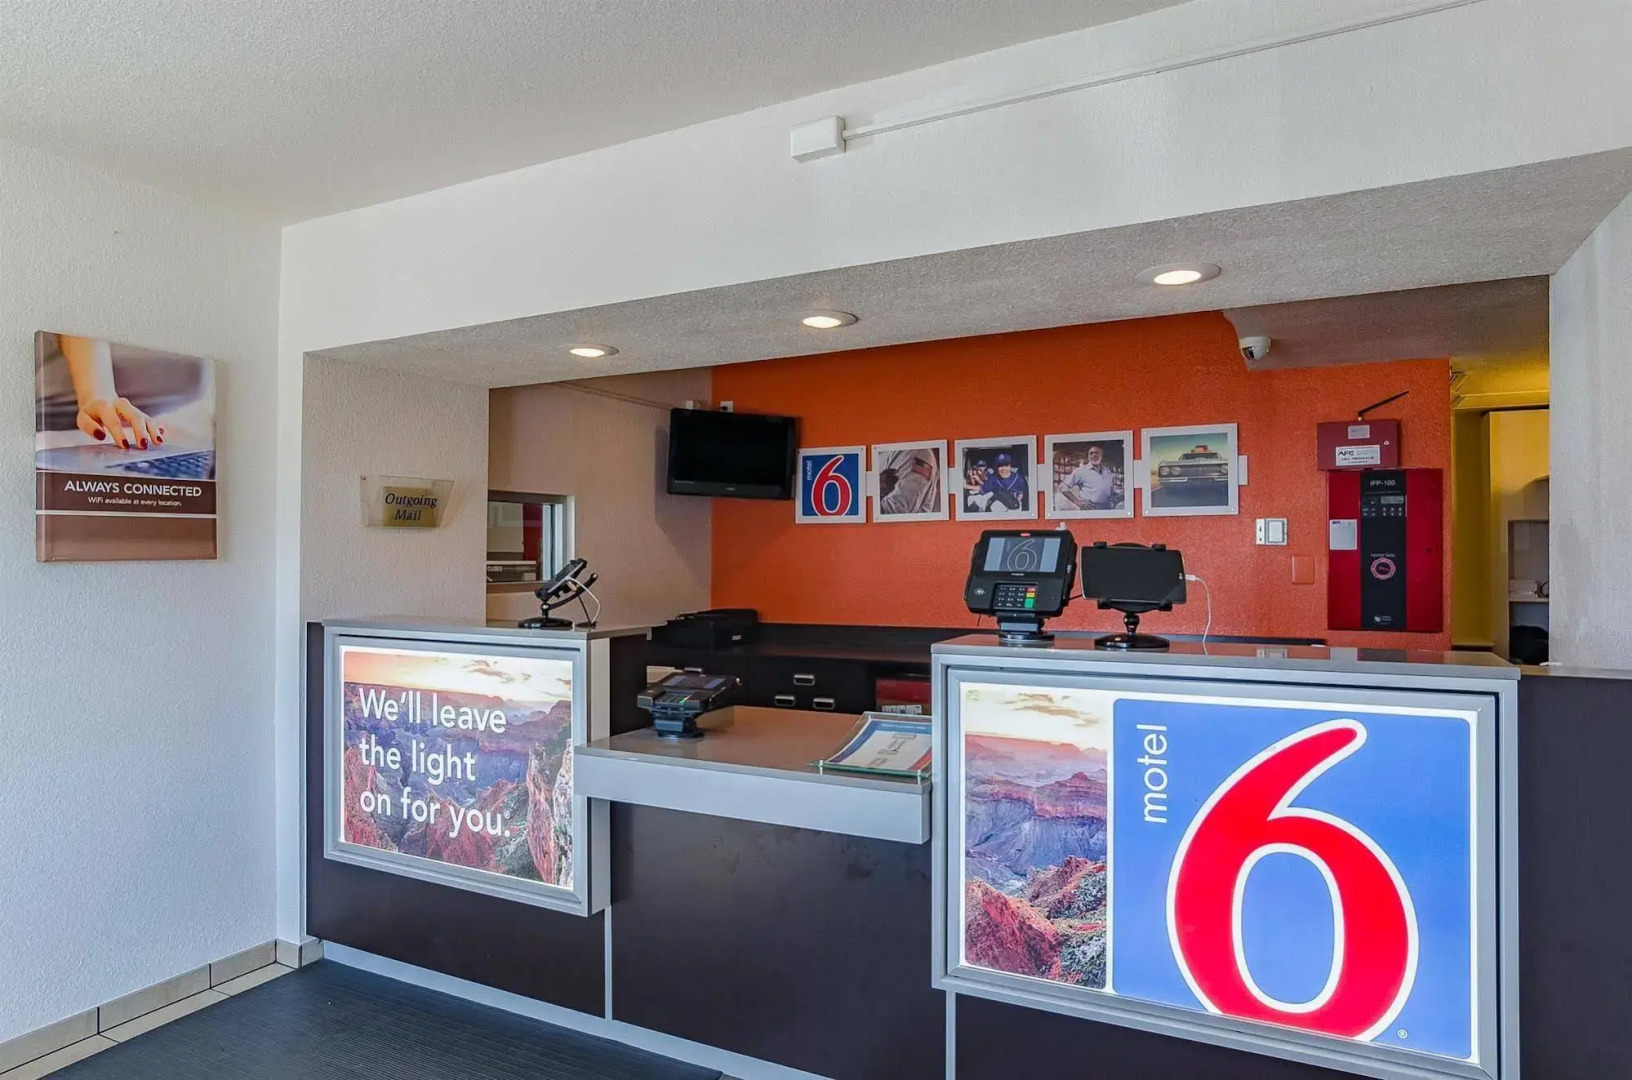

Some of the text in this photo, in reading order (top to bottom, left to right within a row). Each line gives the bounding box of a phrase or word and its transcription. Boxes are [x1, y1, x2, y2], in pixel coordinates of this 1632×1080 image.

[64, 480, 202, 497] ALWAYS CONNECTED
[88, 496, 104, 504] WiFi
[105, 497, 132, 505] available
[385, 493, 438, 509] Outgoing
[811, 455, 852, 516] 6
[395, 509, 422, 521] Mail
[358, 687, 507, 734] We'll leave
[359, 734, 476, 786] the light
[1136, 724, 1168, 824] motel
[360, 790, 391, 816] on
[400, 786, 441, 825] for
[1166, 718, 1420, 1042] 6
